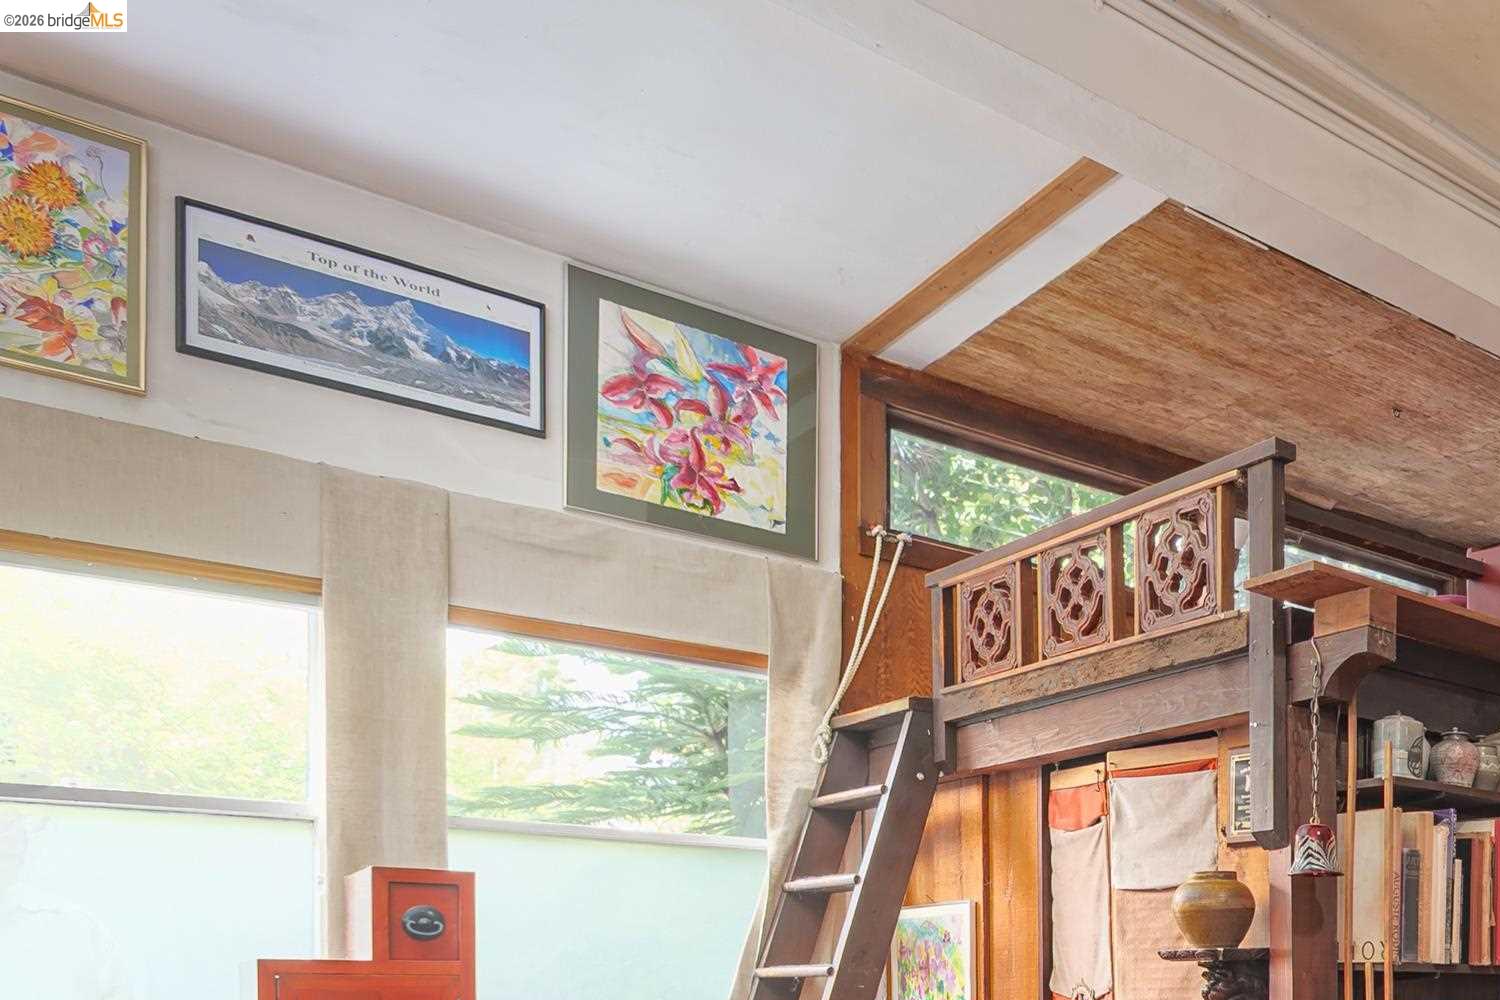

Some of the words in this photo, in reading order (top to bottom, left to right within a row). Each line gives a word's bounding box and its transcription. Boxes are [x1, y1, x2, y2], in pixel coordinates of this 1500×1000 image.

[306, 250, 337, 268] Top
[343, 264, 360, 273] of
[363, 269, 388, 281] the
[393, 276, 440, 297] World
